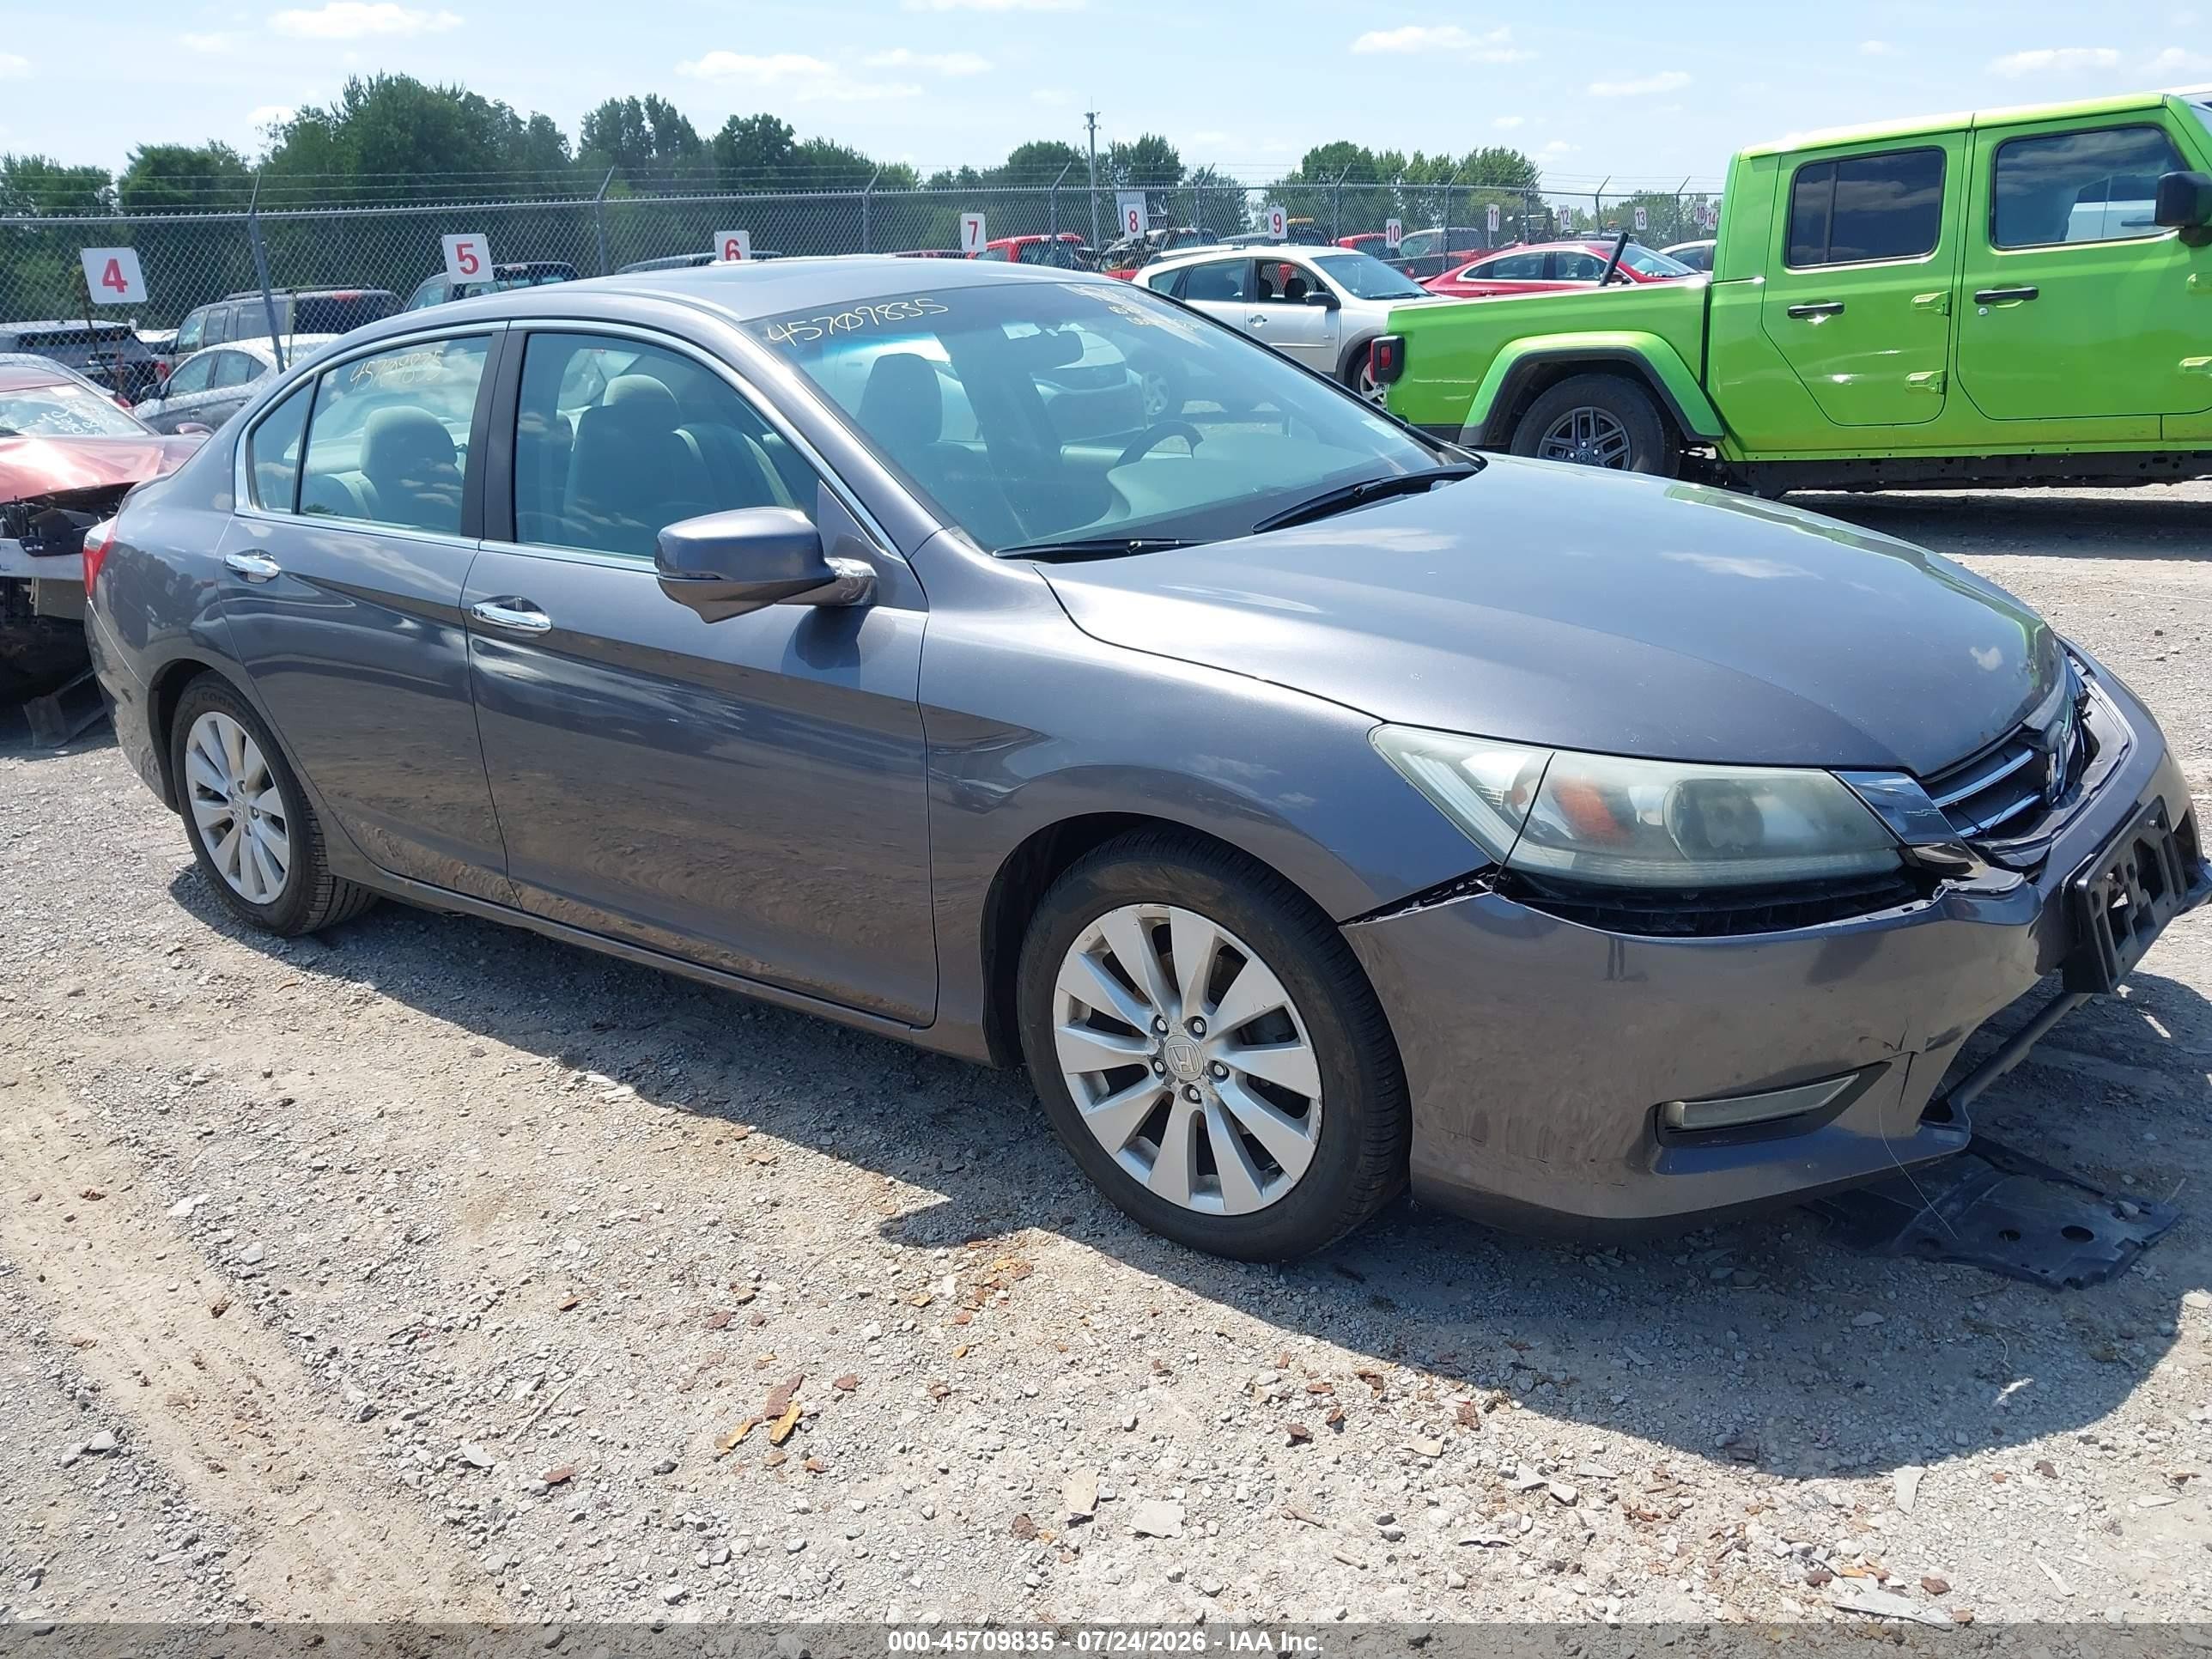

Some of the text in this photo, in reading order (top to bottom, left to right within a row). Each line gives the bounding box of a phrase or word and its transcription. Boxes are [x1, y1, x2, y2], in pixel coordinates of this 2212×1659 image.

[1128, 210, 1139, 233] 8
[1273, 212, 1282, 234] 9
[1490, 210, 1498, 231] 11
[1560, 211, 1570, 225] 12
[1636, 211, 1645, 225] 13
[1708, 212, 1716, 226] 14
[967, 220, 978, 246] 7
[1388, 225, 1401, 242] 10
[455, 242, 479, 275] 5
[725, 239, 741, 261] 6
[102, 258, 128, 293] 4
[768, 299, 949, 347] 45709835
